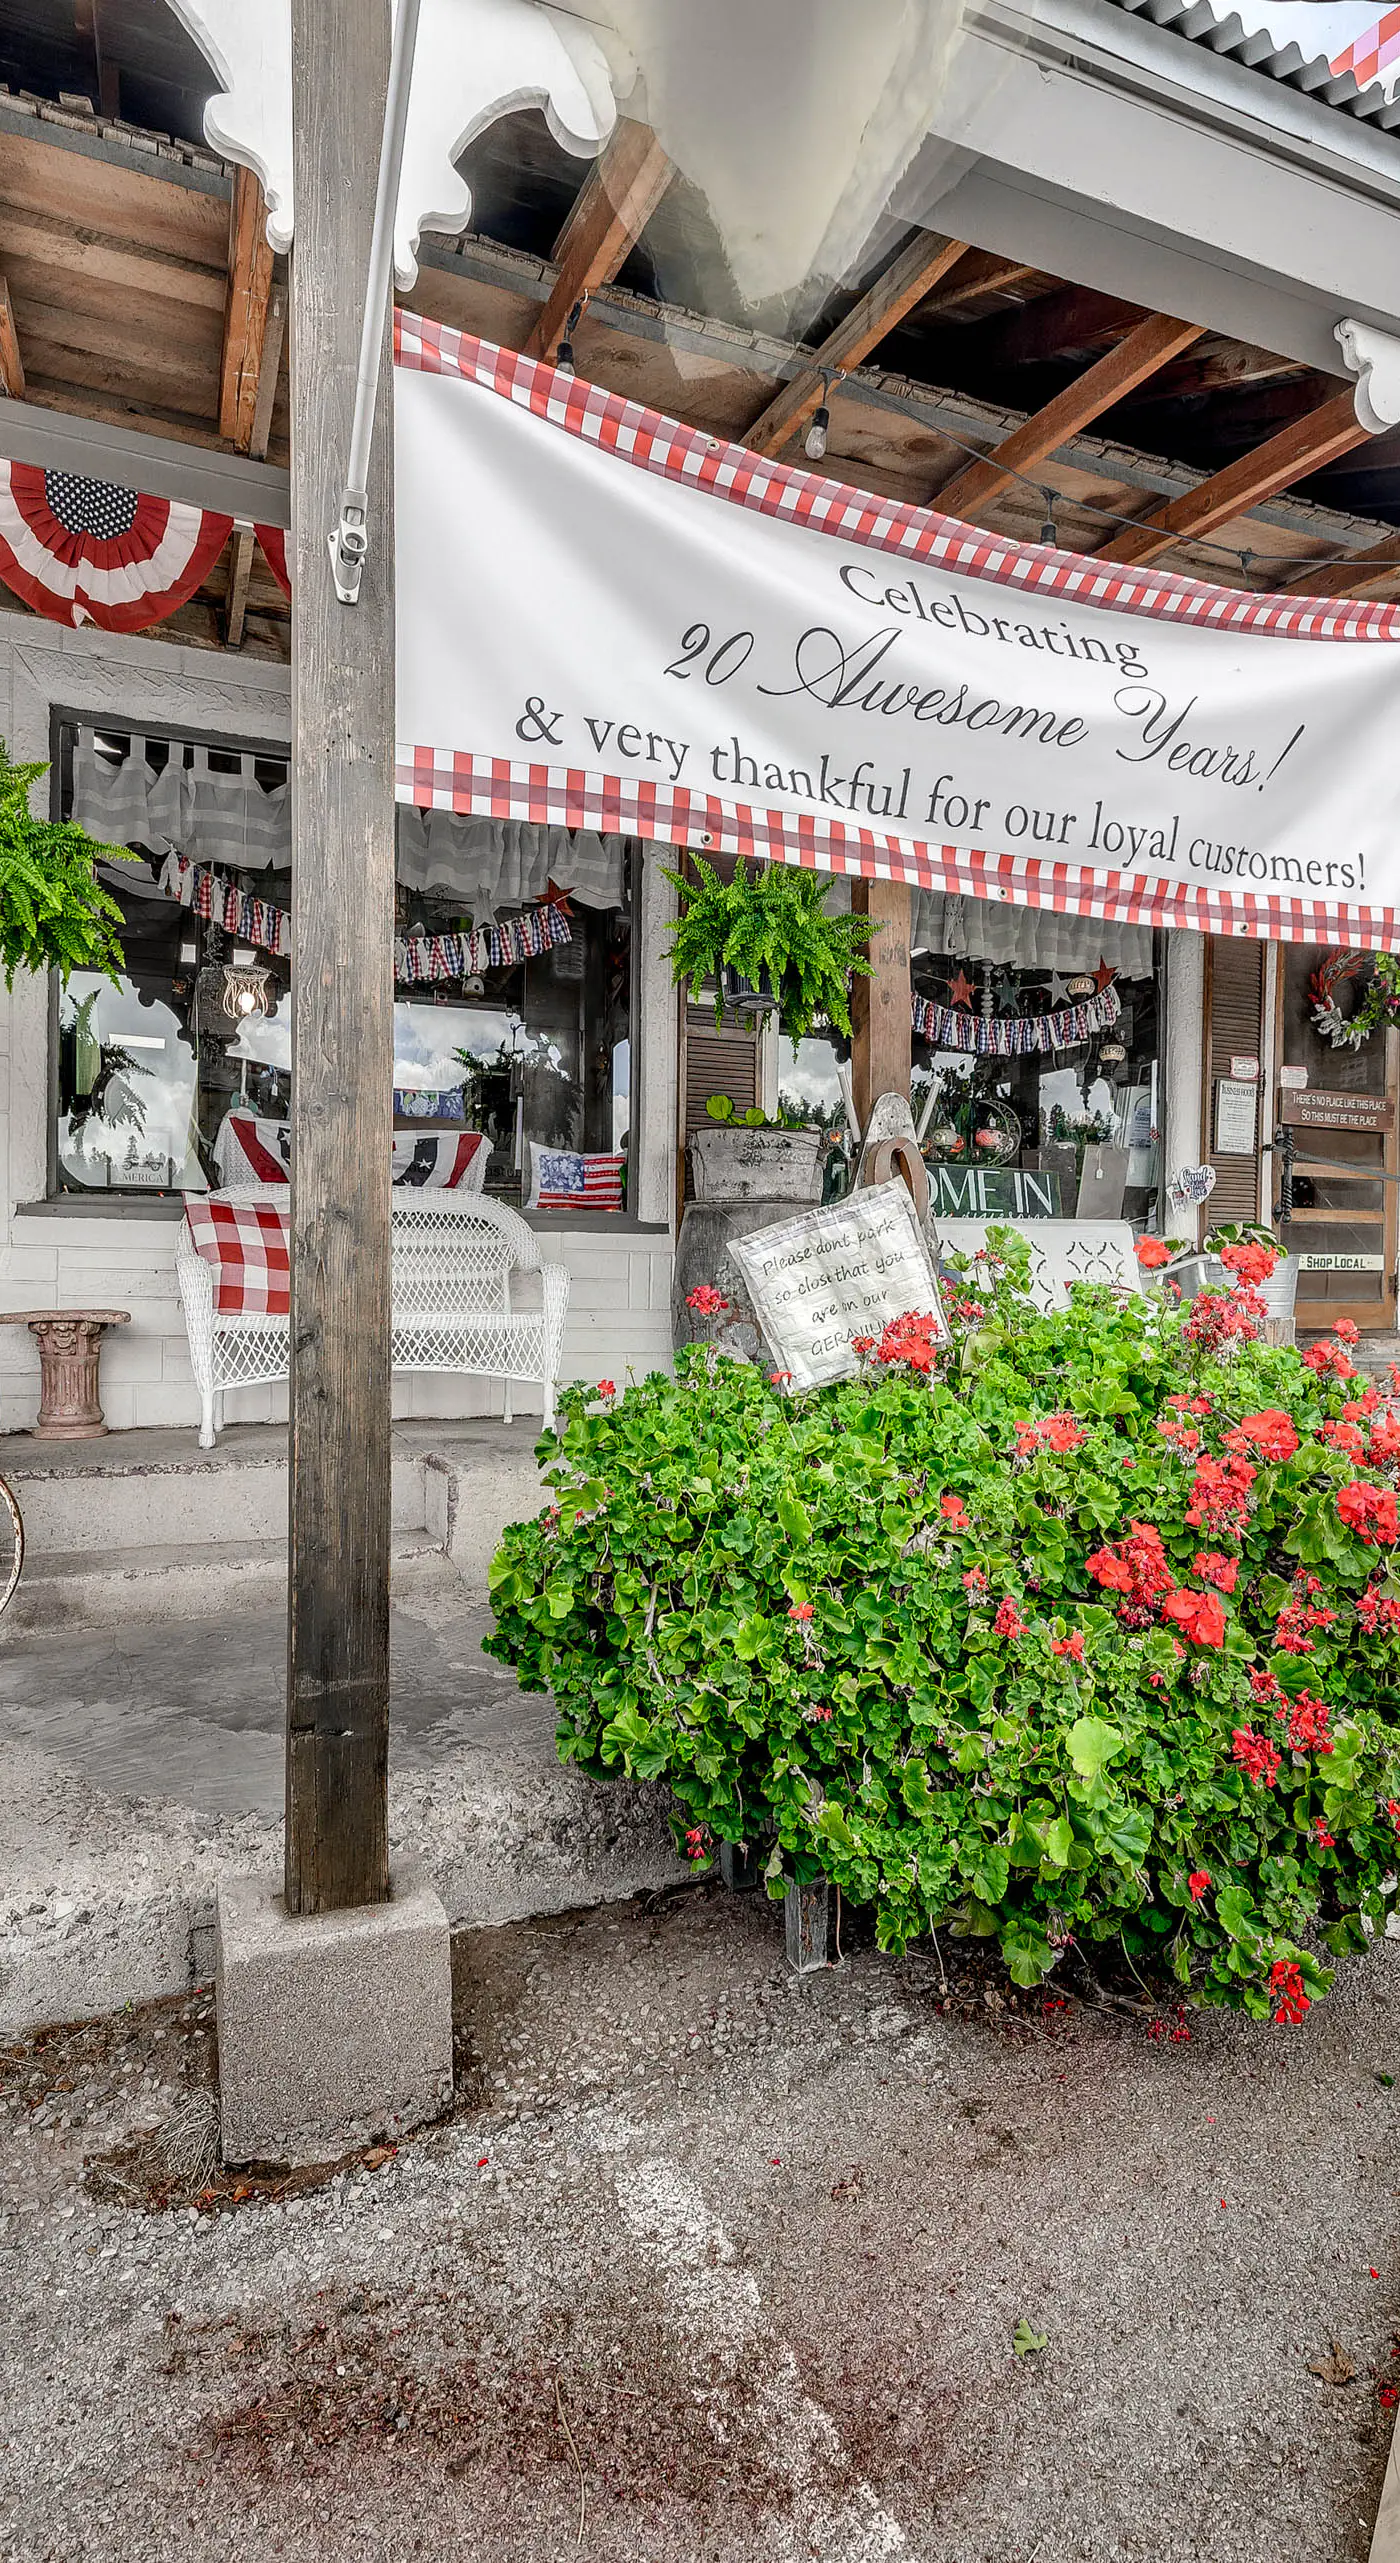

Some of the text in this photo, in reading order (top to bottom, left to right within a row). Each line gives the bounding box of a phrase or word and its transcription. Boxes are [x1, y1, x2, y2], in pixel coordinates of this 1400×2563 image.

[839, 564, 1149, 679] Celebrating
[663, 623, 1306, 792] 20 Awesome Years!
[515, 696, 1367, 891] & very thankful for our loyal customers!
[1301, 1108, 1378, 1127] SO THIS MUST BE THE PLACE
[1316, 1095, 1326, 1106] NO
[1326, 1096, 1344, 1108] PLACE
[1344, 1098, 1356, 1109] LIKE
[1356, 1099, 1369, 1110] THIS
[1369, 1100, 1387, 1112] PLACE
[1014, 1172, 1053, 1214] IN
[762, 1218, 896, 1276] Please dont park
[1306, 1255, 1367, 1269] SHOP LOCAL
[775, 1290, 791, 1305] so
[834, 1262, 869, 1282] that
[875, 1251, 905, 1274] you
[811, 1290, 887, 1323] are in our
